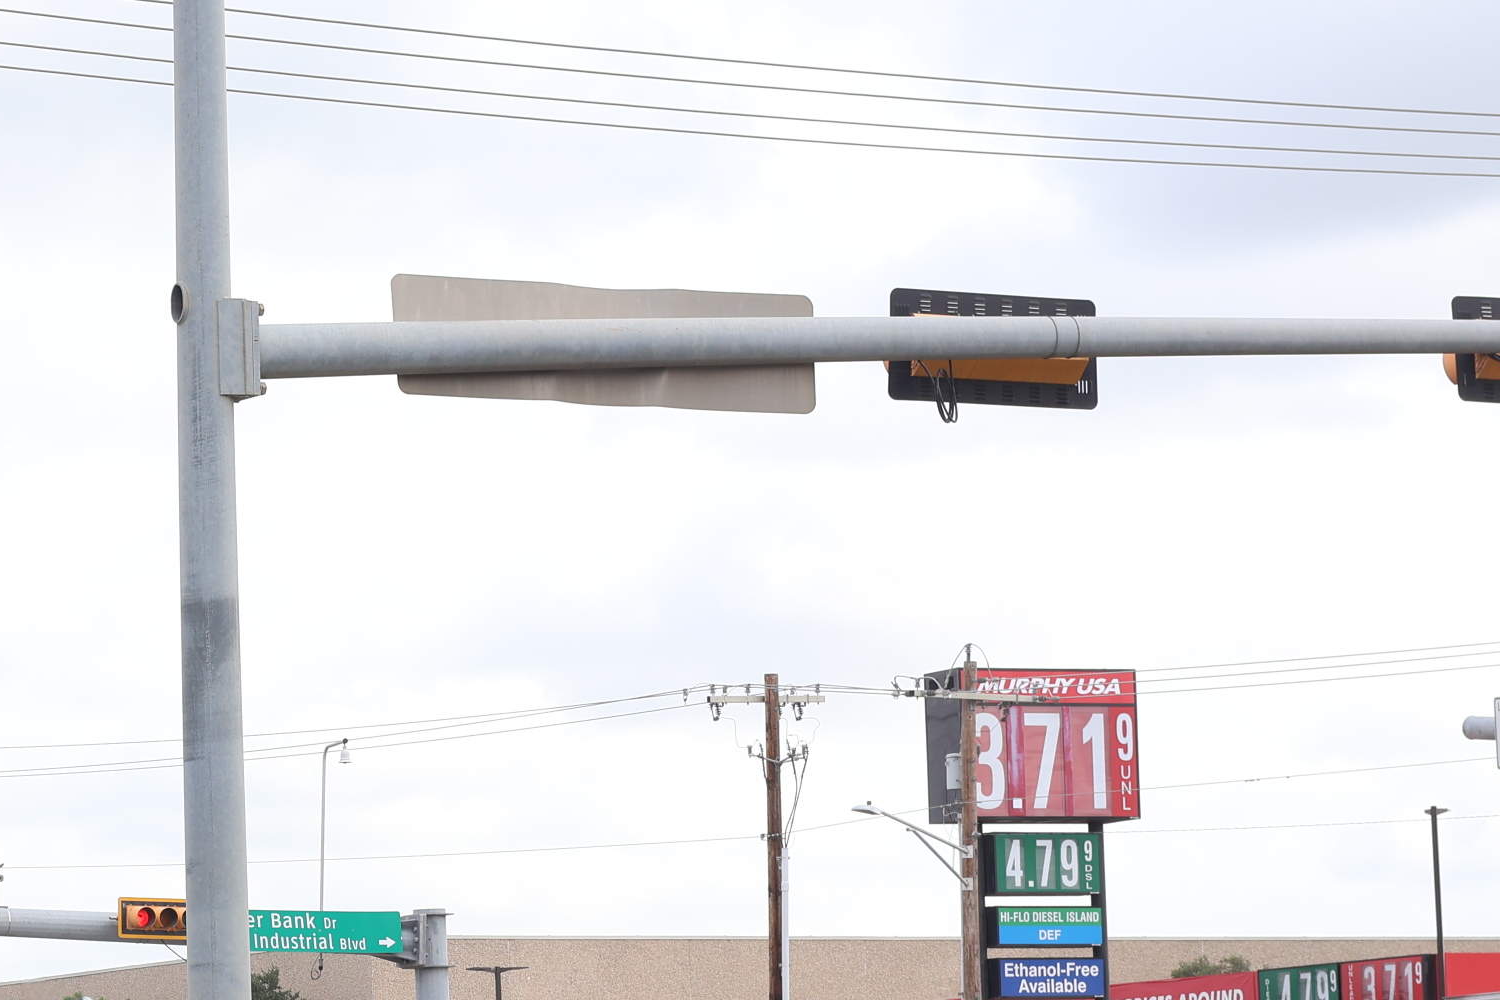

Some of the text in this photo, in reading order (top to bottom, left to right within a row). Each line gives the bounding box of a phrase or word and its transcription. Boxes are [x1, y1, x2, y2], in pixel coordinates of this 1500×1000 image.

[977, 677, 1121, 695] MURPHY USA
[1120, 764, 1132, 811] UNL
[1084, 864, 1093, 890] DSL
[248, 912, 337, 929] er Bank Dr
[1000, 911, 1100, 923] HI-FLO DIESEL ISLAND
[253, 933, 367, 950] Industrial Blvd
[1038, 929, 1062, 941] DEF
[1004, 962, 1100, 978] Ethanol-Free
[1018, 979, 1088, 994] Available
